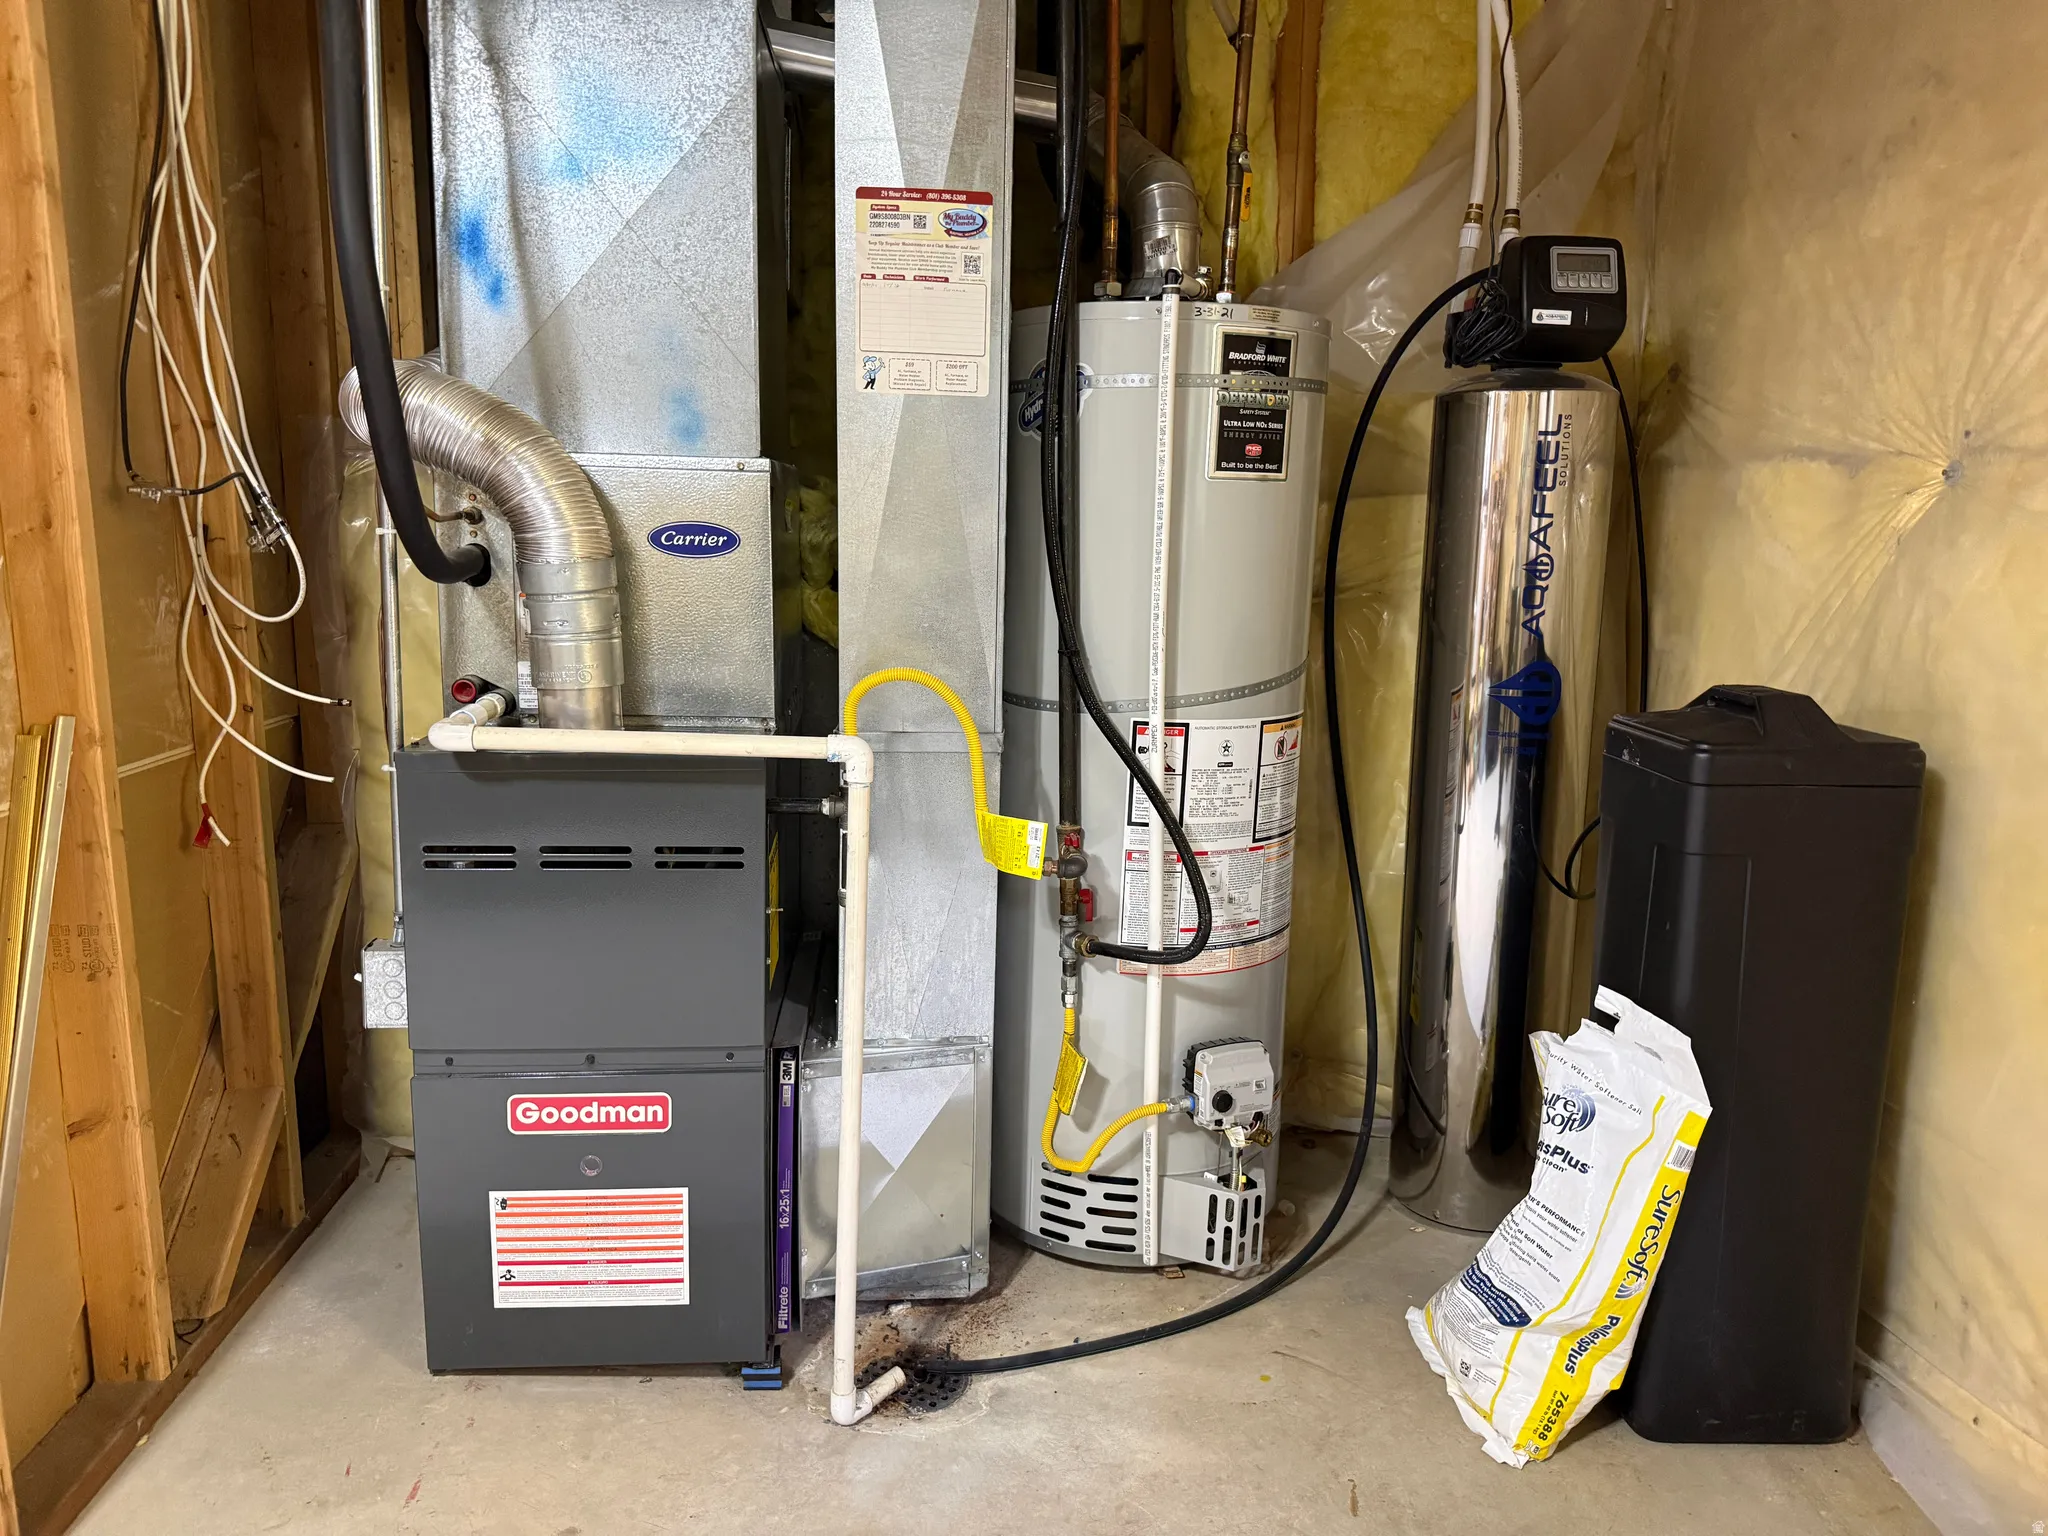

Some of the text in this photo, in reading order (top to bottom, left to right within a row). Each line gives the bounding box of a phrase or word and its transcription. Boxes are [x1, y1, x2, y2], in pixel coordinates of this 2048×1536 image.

[1194, 306, 1234, 319] 3-31-21
[1228, 352, 1288, 364] BRADFORD WHITE
[1024, 398, 1044, 422] Hydr
[1217, 390, 1290, 408] DEFENDER
[1559, 414, 1572, 487] SOLUTIONS
[661, 530, 728, 546] Carrier
[82, 938, 92, 958] STUD
[782, 1063, 793, 1081] 3M
[1570, 1063, 1593, 1083] Water
[1594, 1081, 1626, 1106] Softener
[1628, 1102, 1643, 1116] Salt
[516, 1102, 664, 1124] Goodman
[1542, 1106, 1581, 1134] Soft
[1542, 1156, 1565, 1174] Clean
[779, 1188, 790, 1230] 16x25x1
[1528, 1192, 1540, 1206] ER'S
[1547, 1220, 1560, 1232] water
[1560, 1229, 1578, 1244] softener
[1626, 1185, 1681, 1282] SureSoft
[1509, 1248, 1532, 1266] detergents
[1524, 1232, 1536, 1245] Soft
[1536, 1242, 1554, 1260] Water
[1536, 1260, 1548, 1274] water
[1490, 1286, 1506, 1300] water
[778, 1286, 789, 1330] Filtrete
[1565, 1315, 1621, 1374] PelletsPlus
[1538, 1391, 1570, 1441] 765388
